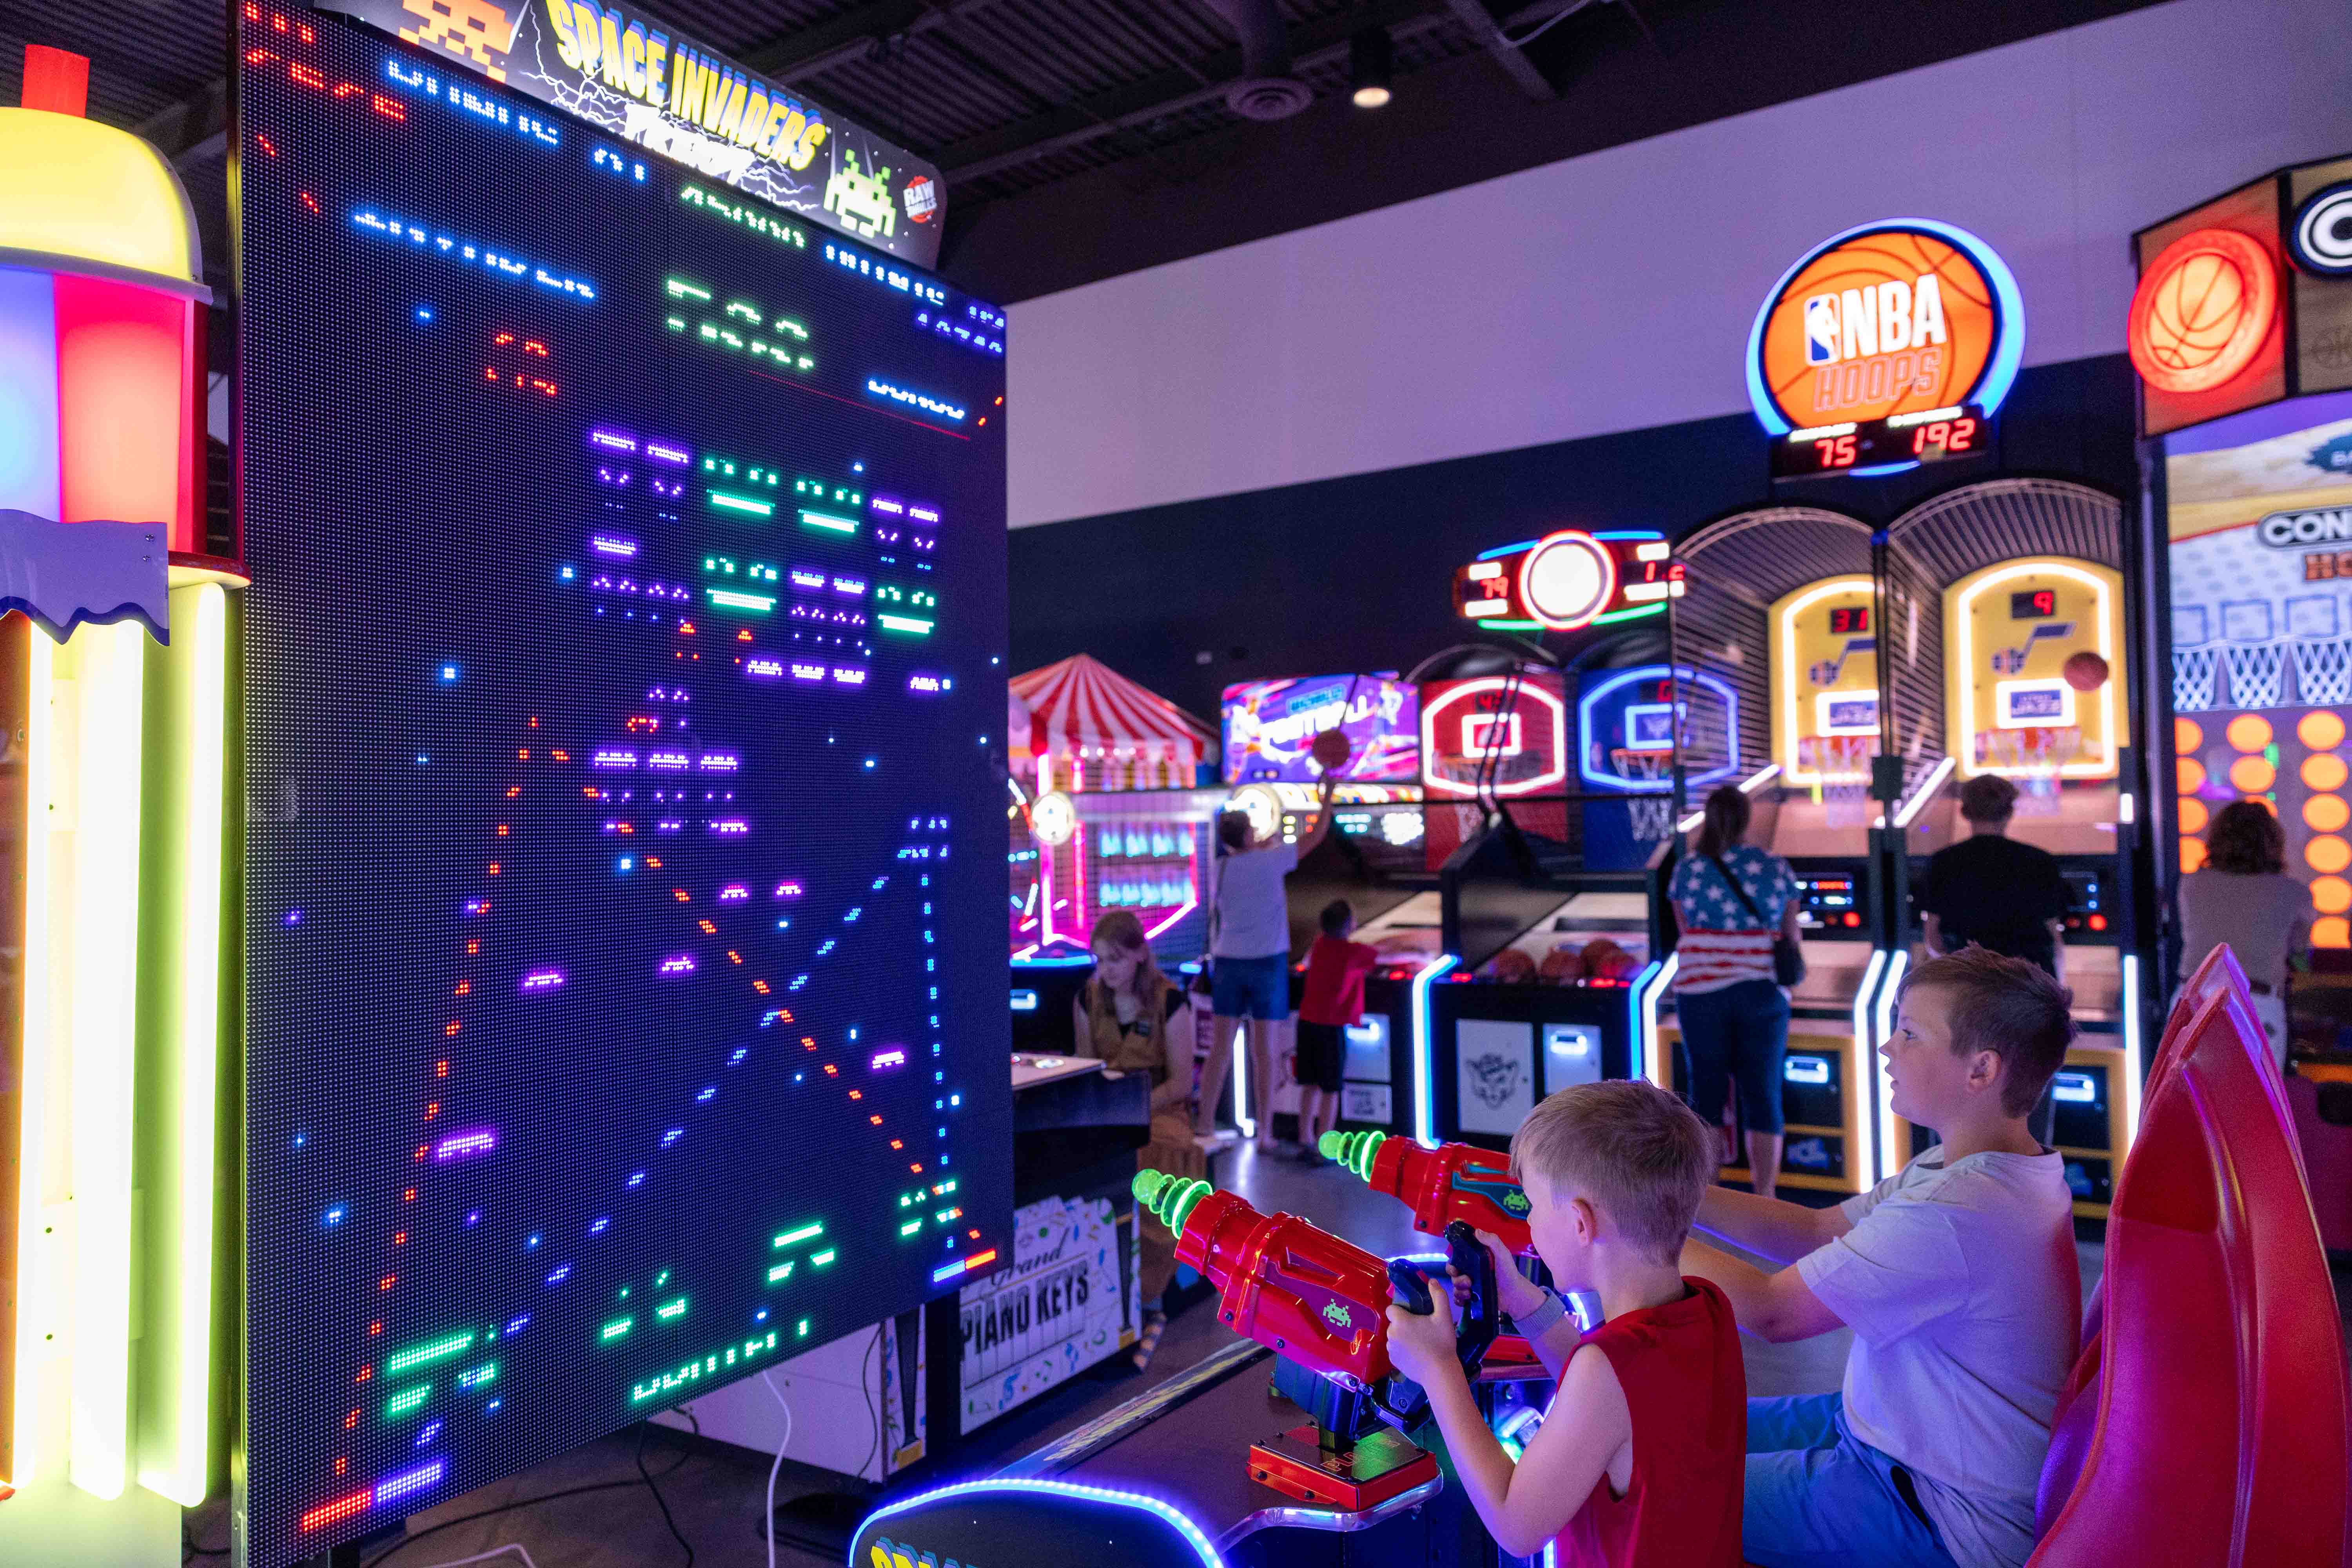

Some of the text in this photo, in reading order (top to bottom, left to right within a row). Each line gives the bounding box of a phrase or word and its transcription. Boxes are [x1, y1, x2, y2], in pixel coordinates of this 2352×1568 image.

[546, 0, 668, 107] SPACE
[671, 44, 826, 171] INVADERS
[1841, 273, 1947, 359] NBA
[1813, 347, 1943, 413] HOOPS
[1814, 435, 1857, 467] 75
[1913, 418, 1976, 455] 192
[1834, 609, 1868, 633] 31
[2033, 591, 2054, 615] 9
[960, 1260, 1089, 1355] PIANO KEYS
